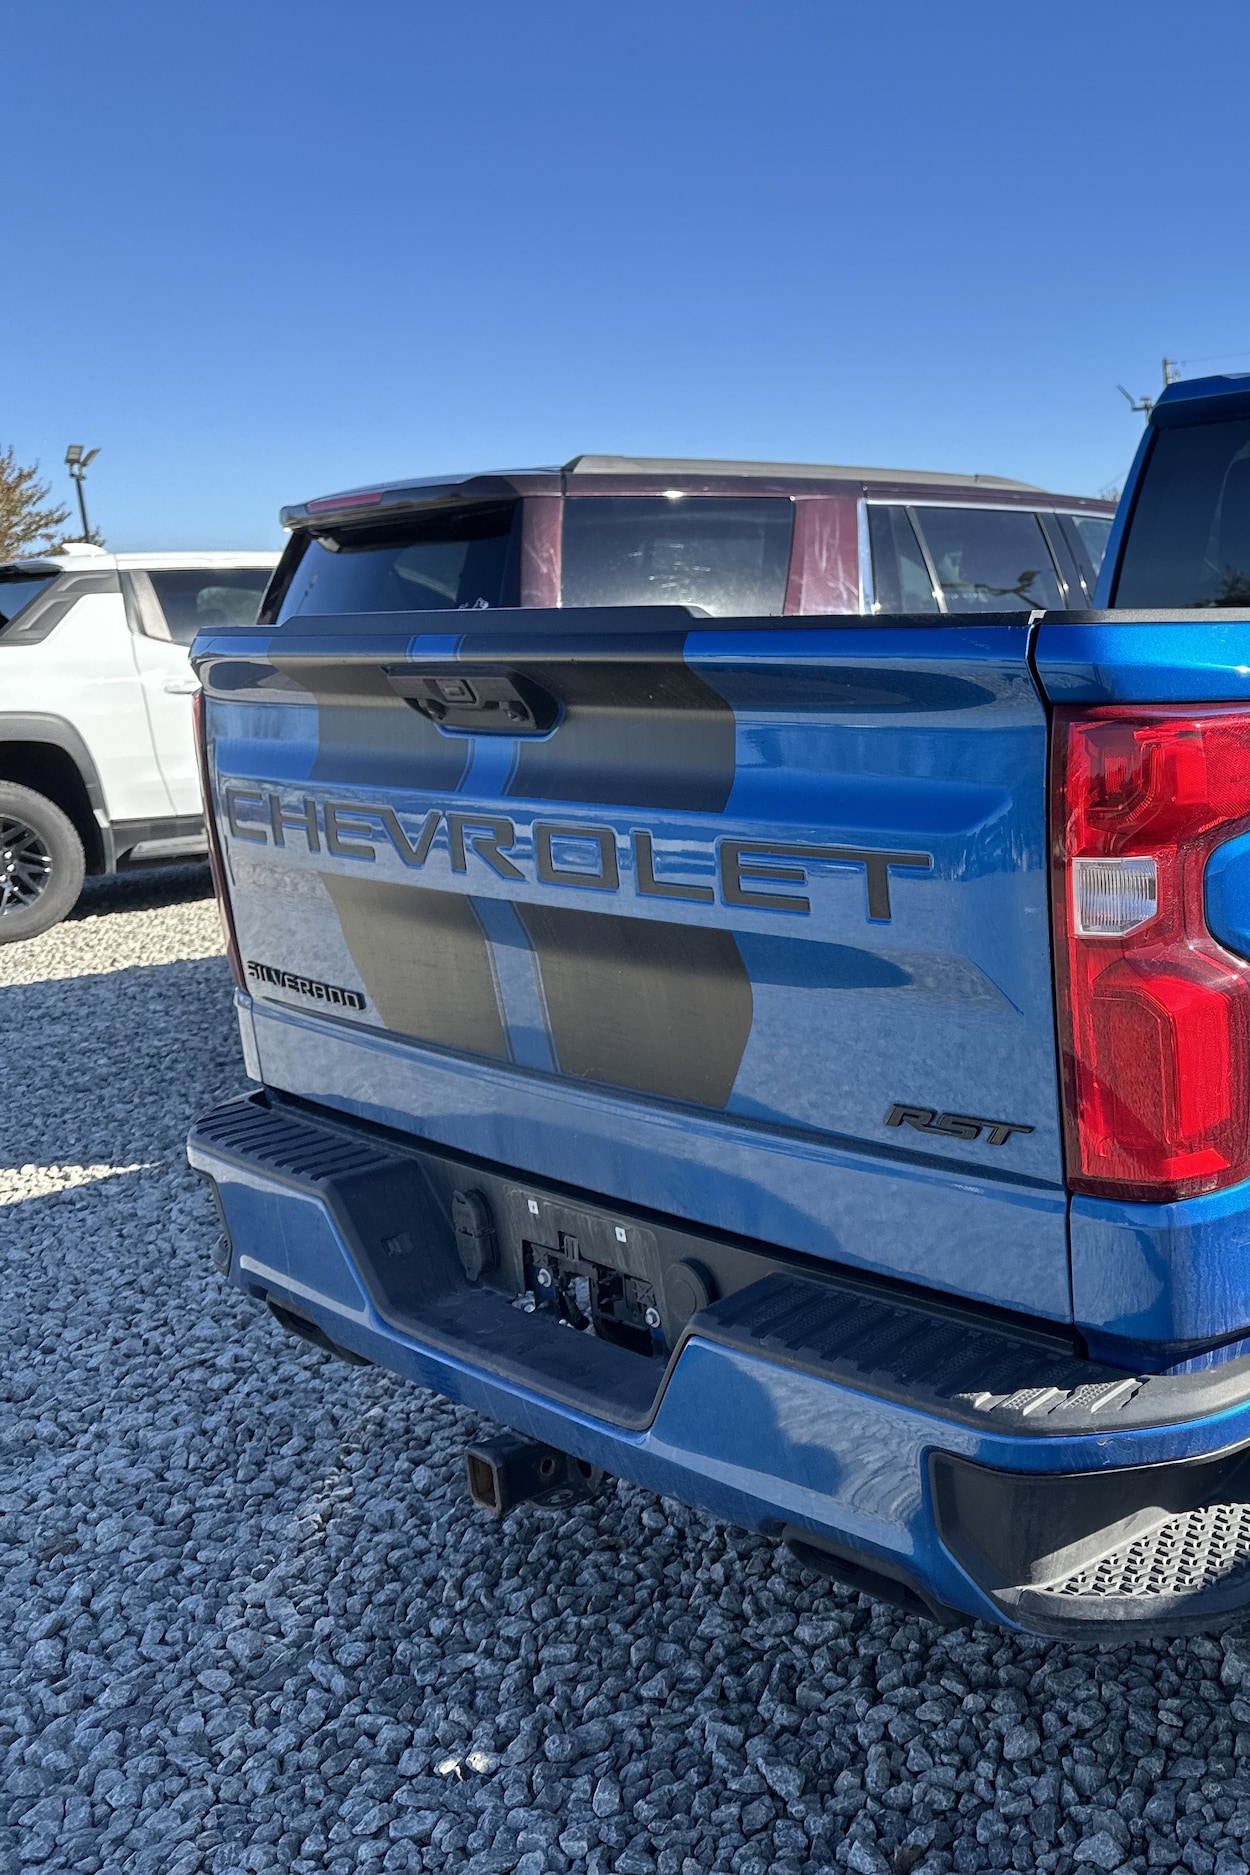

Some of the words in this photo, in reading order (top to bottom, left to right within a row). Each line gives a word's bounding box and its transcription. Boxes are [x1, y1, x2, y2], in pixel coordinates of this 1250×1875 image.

[224, 787, 934, 923] CHEVROLET
[247, 960, 367, 1010] SILVERADO
[885, 1103, 1036, 1145] RST
